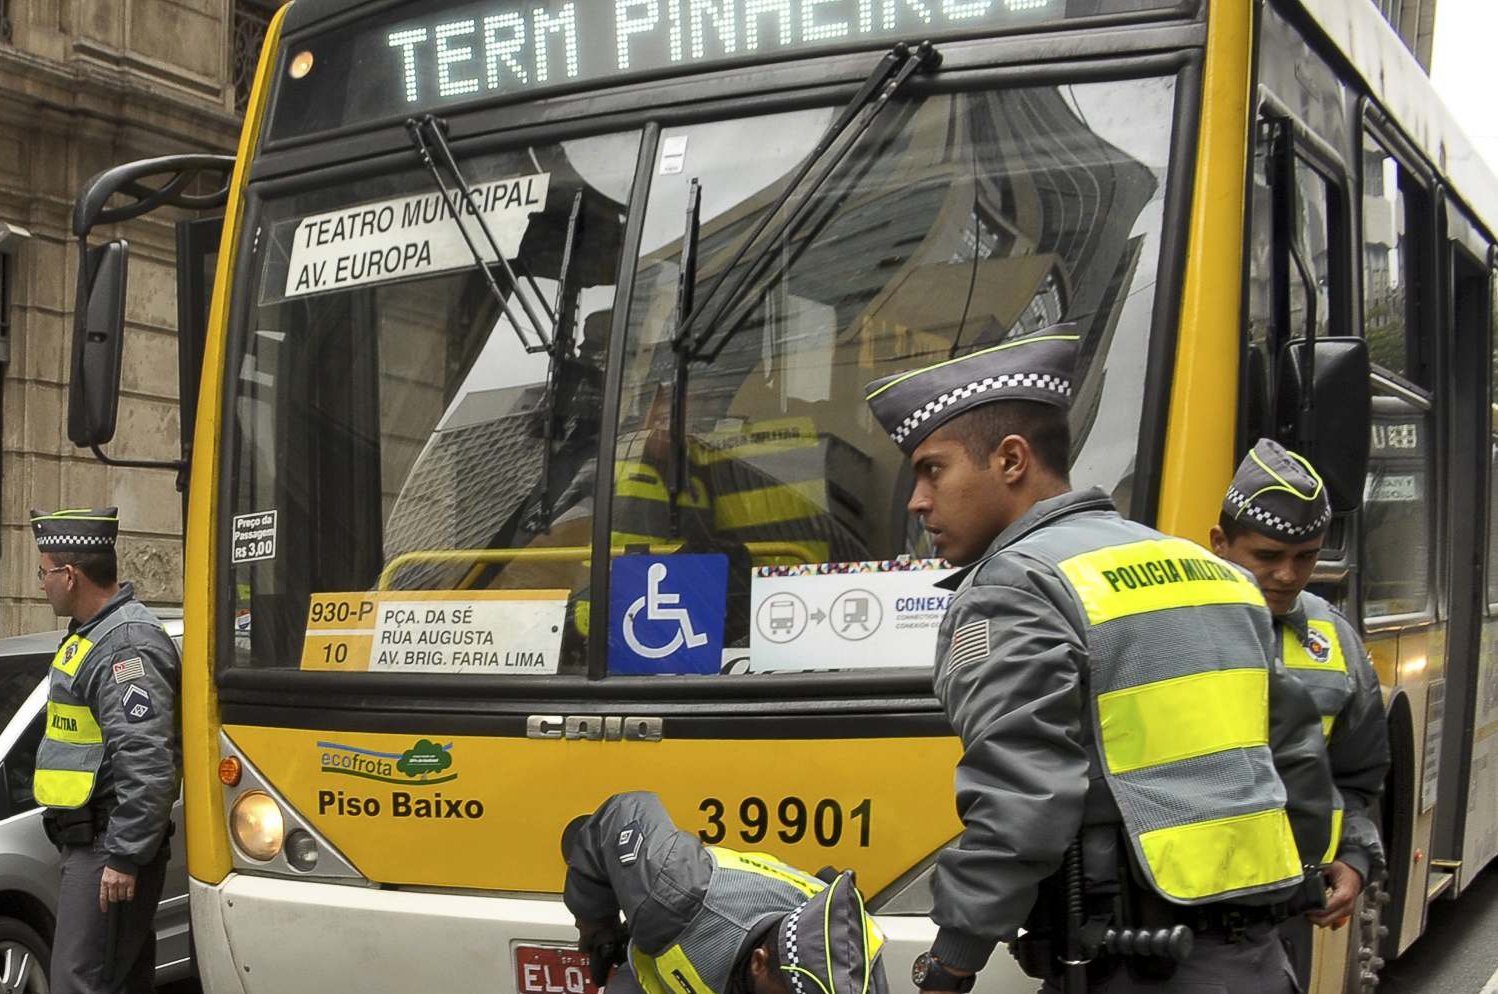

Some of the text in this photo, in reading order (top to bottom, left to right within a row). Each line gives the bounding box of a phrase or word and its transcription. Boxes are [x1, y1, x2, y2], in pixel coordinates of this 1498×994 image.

[389, 0, 1049, 102] TERM PINHE
[305, 178, 540, 248] TEATRO MUNICIPAL
[295, 240, 432, 292] AV. EUROPA
[237, 515, 273, 529] Preço da
[234, 528, 276, 541] Passagem
[235, 540, 273, 558] R$ 3,00
[1101, 558, 1184, 592] POLICIA
[310, 601, 374, 623] 930-P
[896, 594, 953, 612] CONEX
[384, 606, 473, 628] PÇA. DA SÉ
[381, 630, 494, 645] RUA AUGUSTA
[323, 643, 348, 663] 10
[377, 651, 545, 667] AV. BRIG. FARIA LIMA
[526, 715, 663, 742] CAIO
[321, 752, 392, 776] ecofrota
[318, 790, 485, 819] Piso Baixo
[698, 796, 872, 848] 39901
